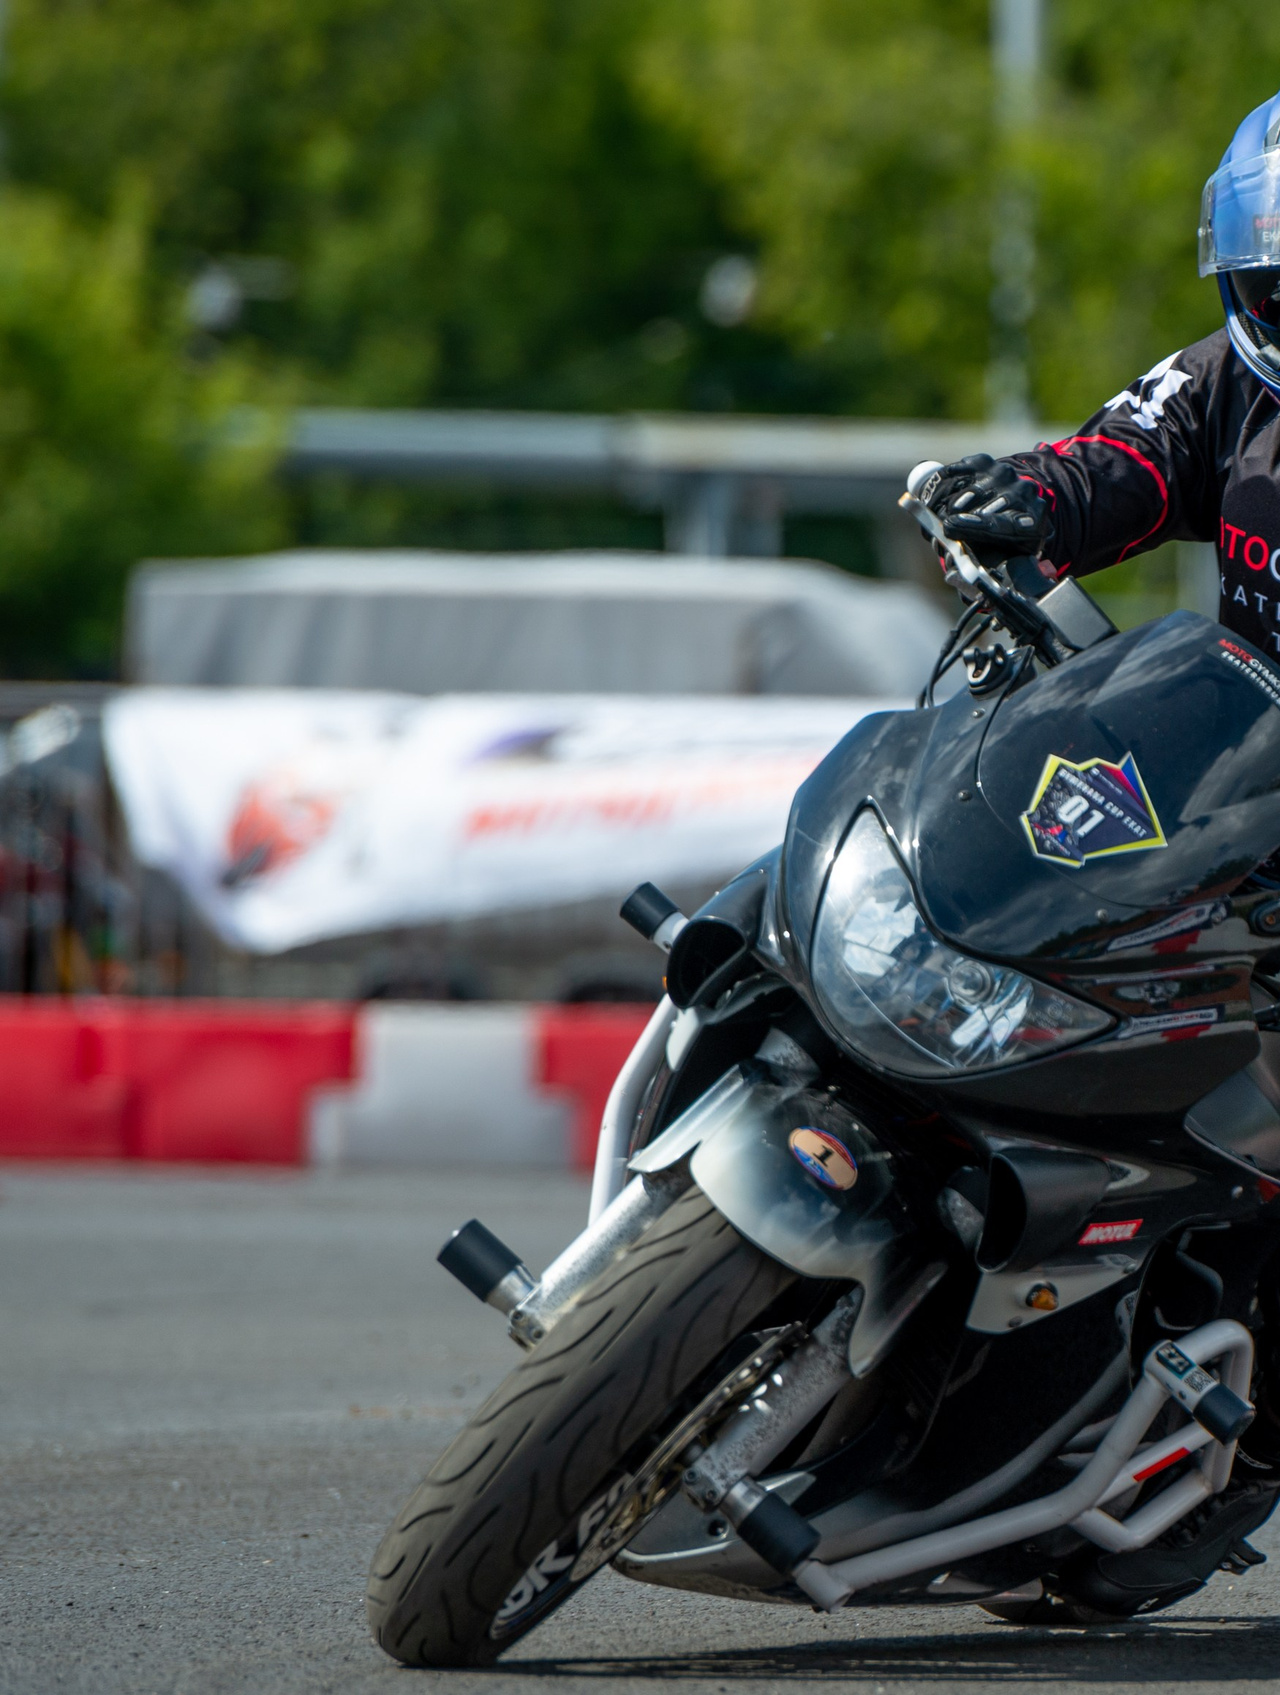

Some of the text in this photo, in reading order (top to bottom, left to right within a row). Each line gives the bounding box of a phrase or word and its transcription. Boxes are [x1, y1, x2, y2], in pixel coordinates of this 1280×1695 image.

[1056, 795, 1105, 839] 01
[1104, 802, 1124, 818] CUP
[1081, 1222, 1138, 1245] MOTUL
